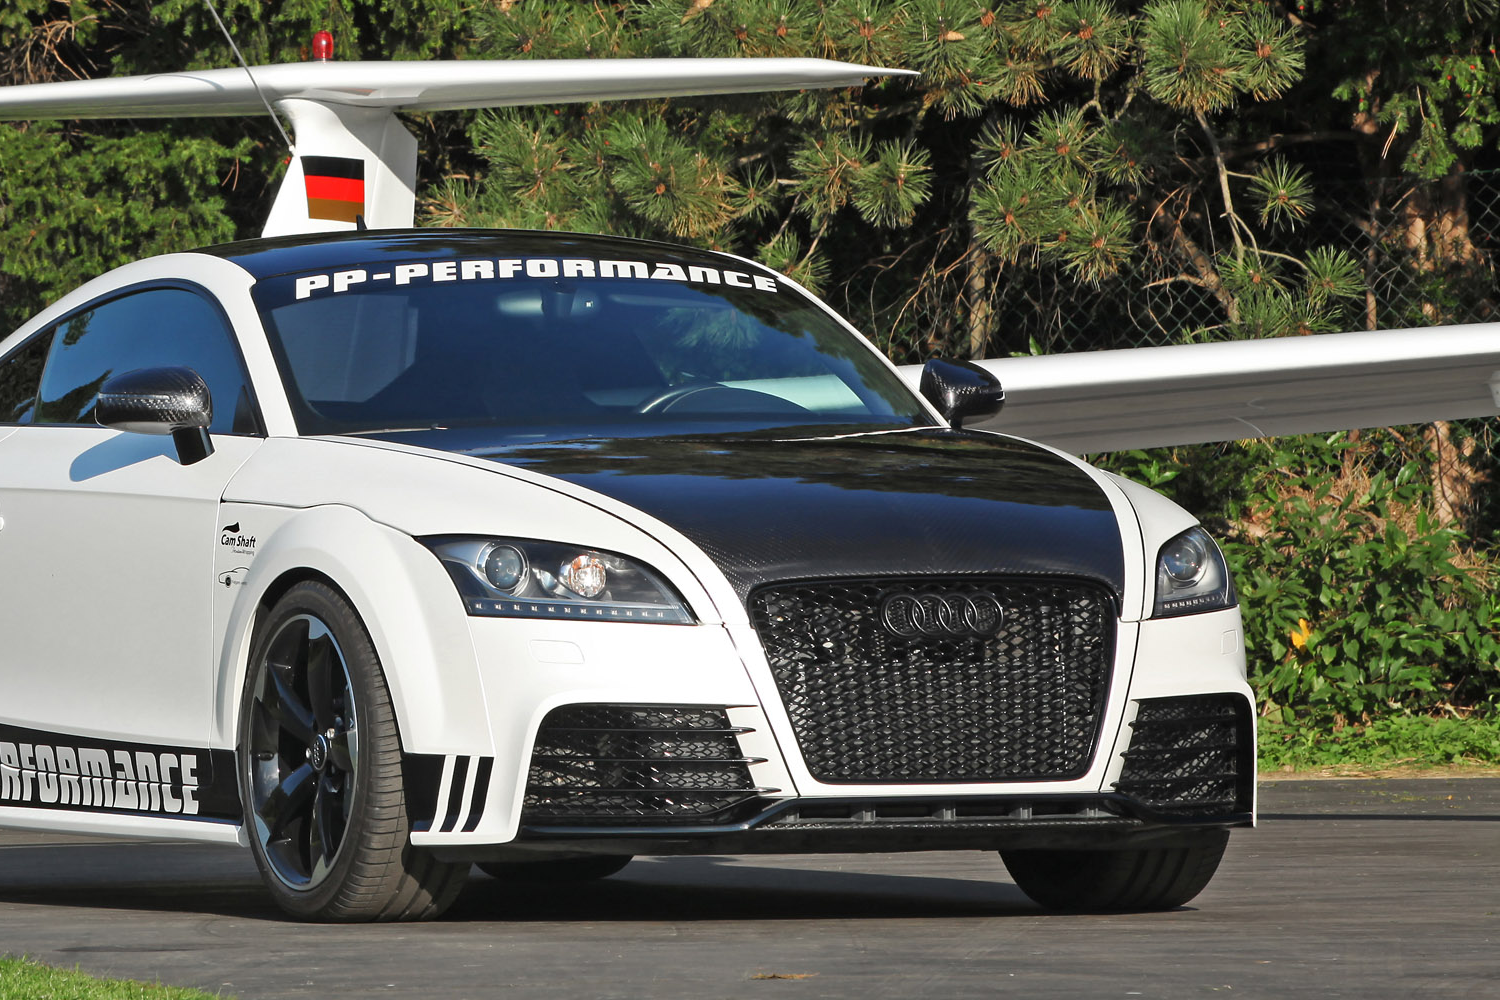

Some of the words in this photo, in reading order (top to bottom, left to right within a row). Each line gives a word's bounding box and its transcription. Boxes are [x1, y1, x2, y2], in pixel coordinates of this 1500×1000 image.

[296, 259, 778, 299] PP-PERFORMANCE
[221, 534, 236, 546] Cam
[236, 536, 256, 548] Shaft
